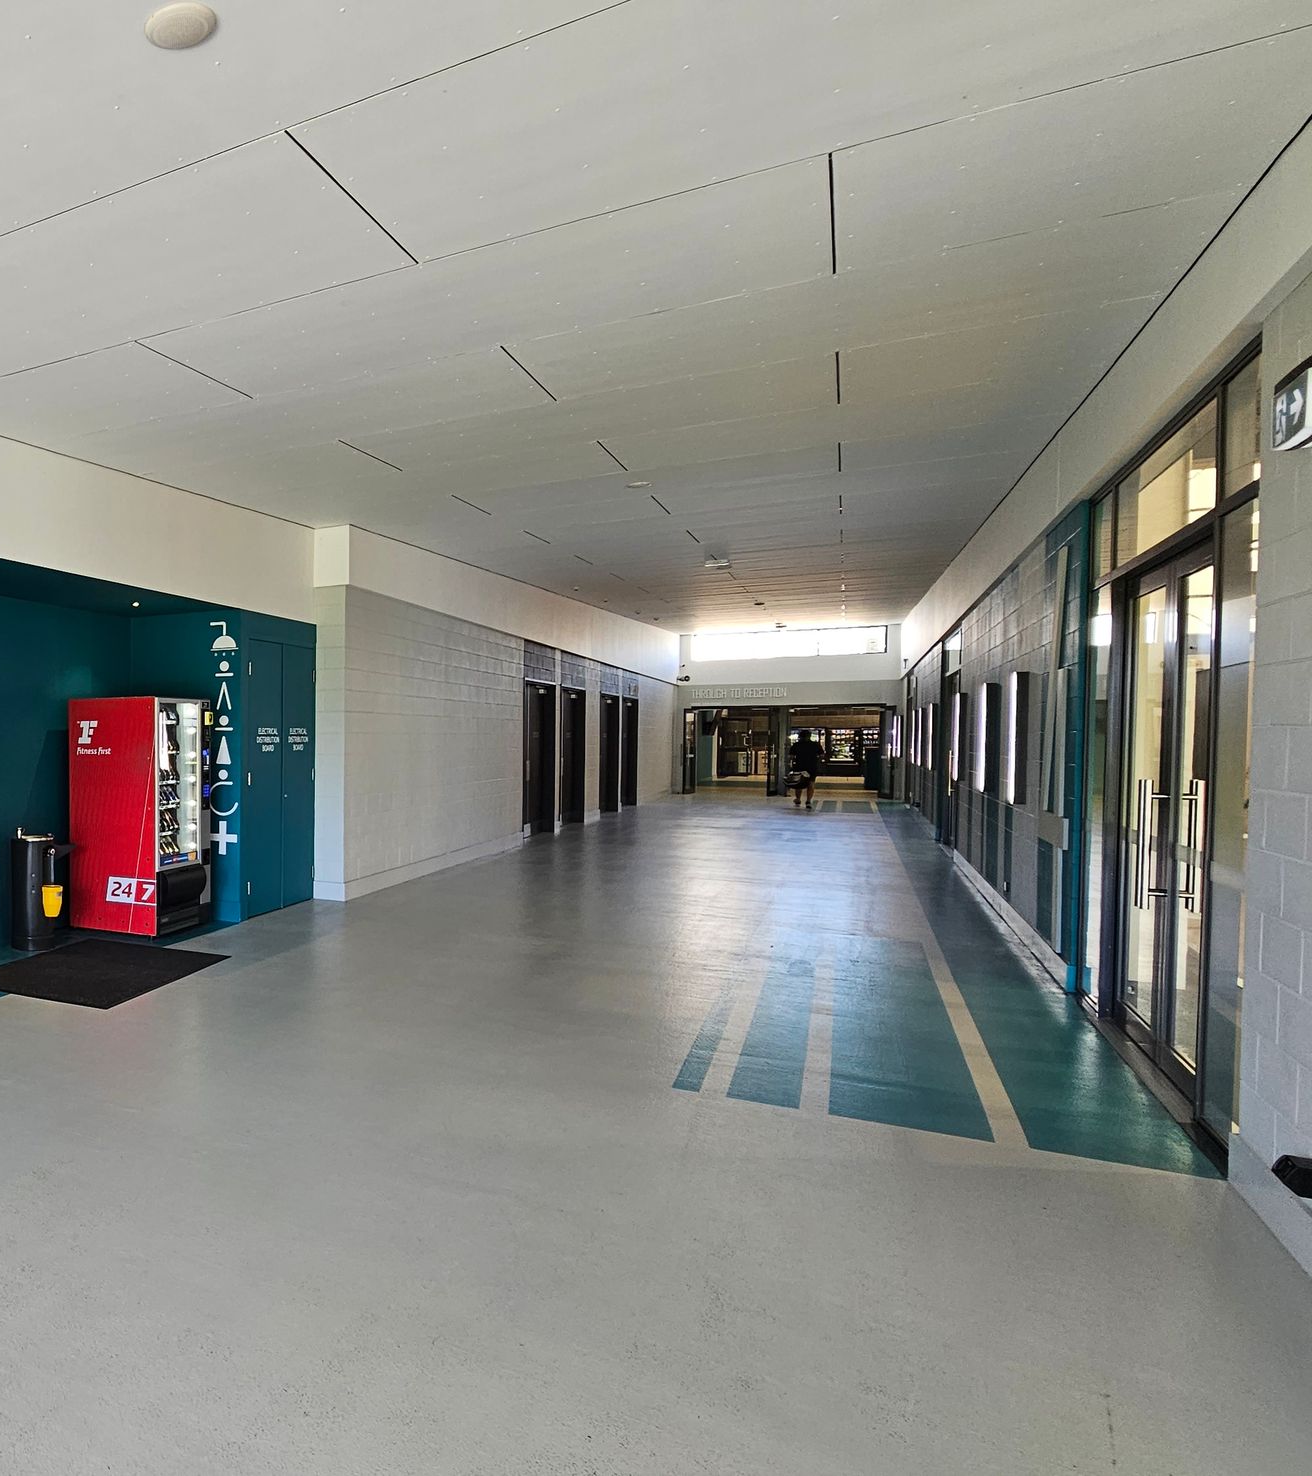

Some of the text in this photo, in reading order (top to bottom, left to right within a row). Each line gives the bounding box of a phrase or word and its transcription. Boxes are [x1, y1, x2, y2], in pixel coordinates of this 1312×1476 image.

[691, 687, 787, 699] THROUGH TO RECEPTION
